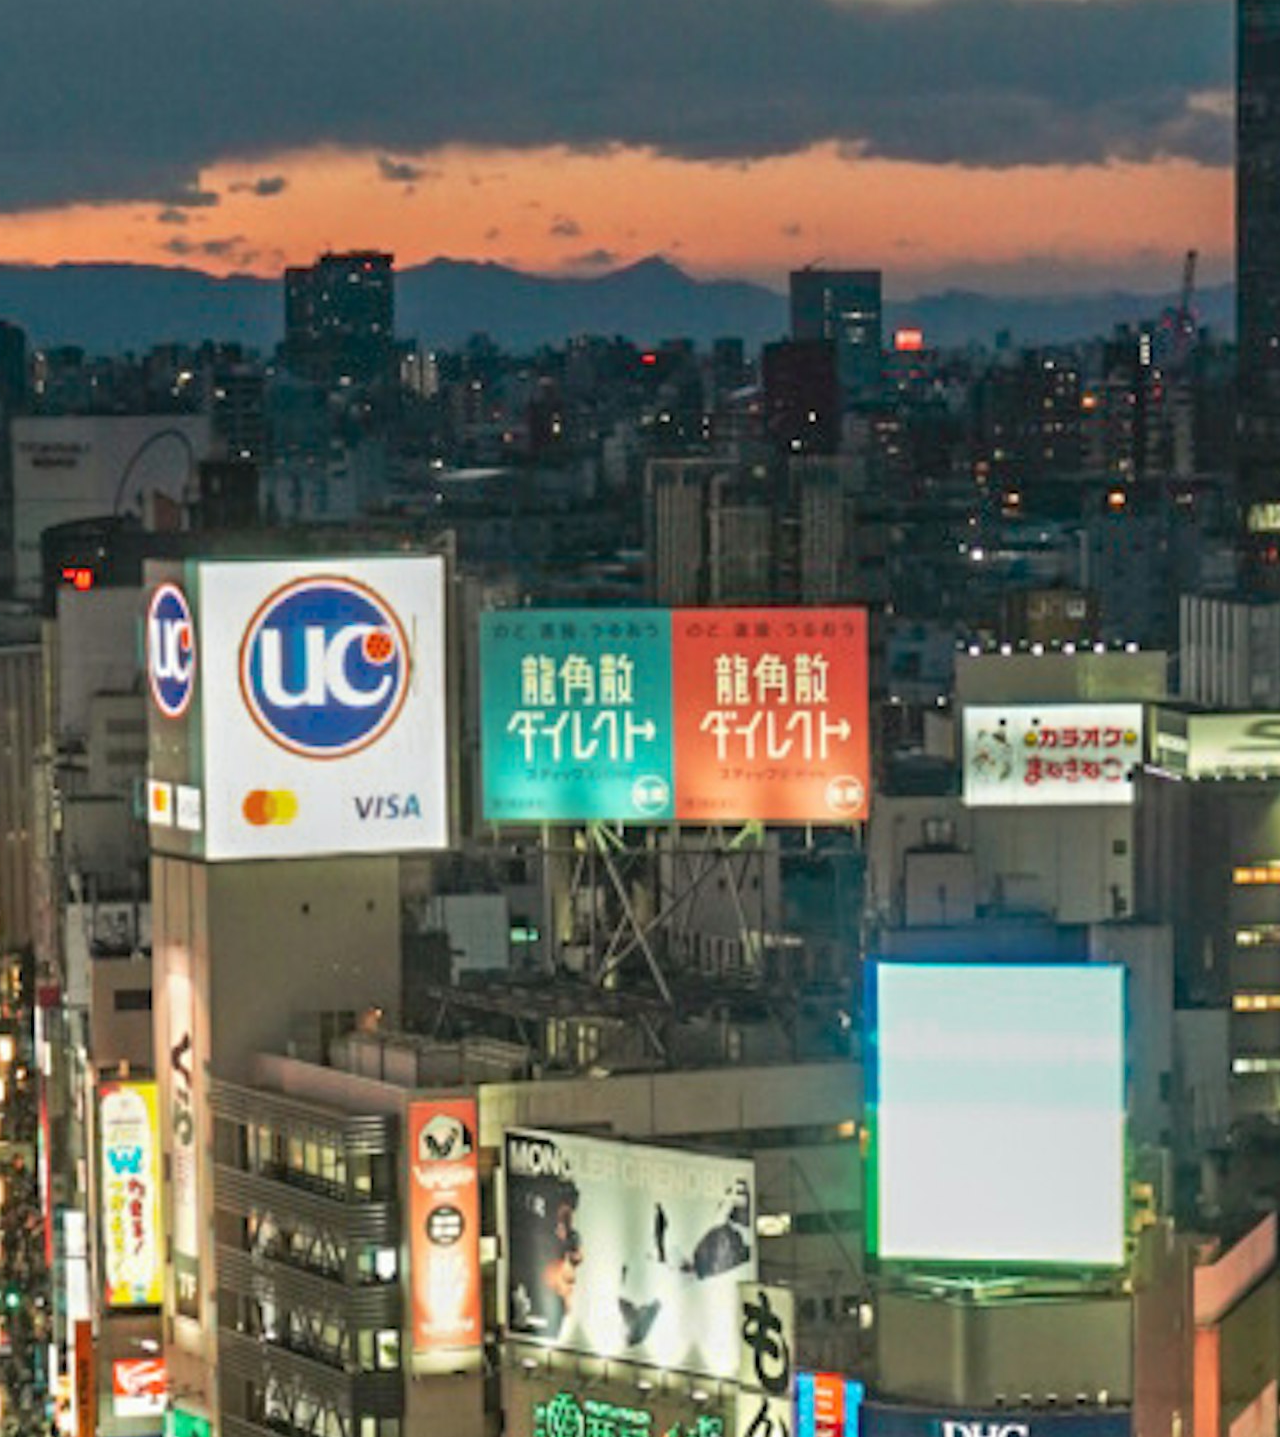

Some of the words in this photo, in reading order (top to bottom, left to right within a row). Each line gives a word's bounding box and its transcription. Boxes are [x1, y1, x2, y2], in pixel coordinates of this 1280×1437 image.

[521, 653, 633, 705] 龍角散
[715, 653, 828, 705] 龍角散
[507, 711, 656, 761] ダイレクト
[699, 711, 851, 760] ダイレクト
[1037, 726, 1121, 748] カラオケ
[355, 794, 421, 819] VISA
